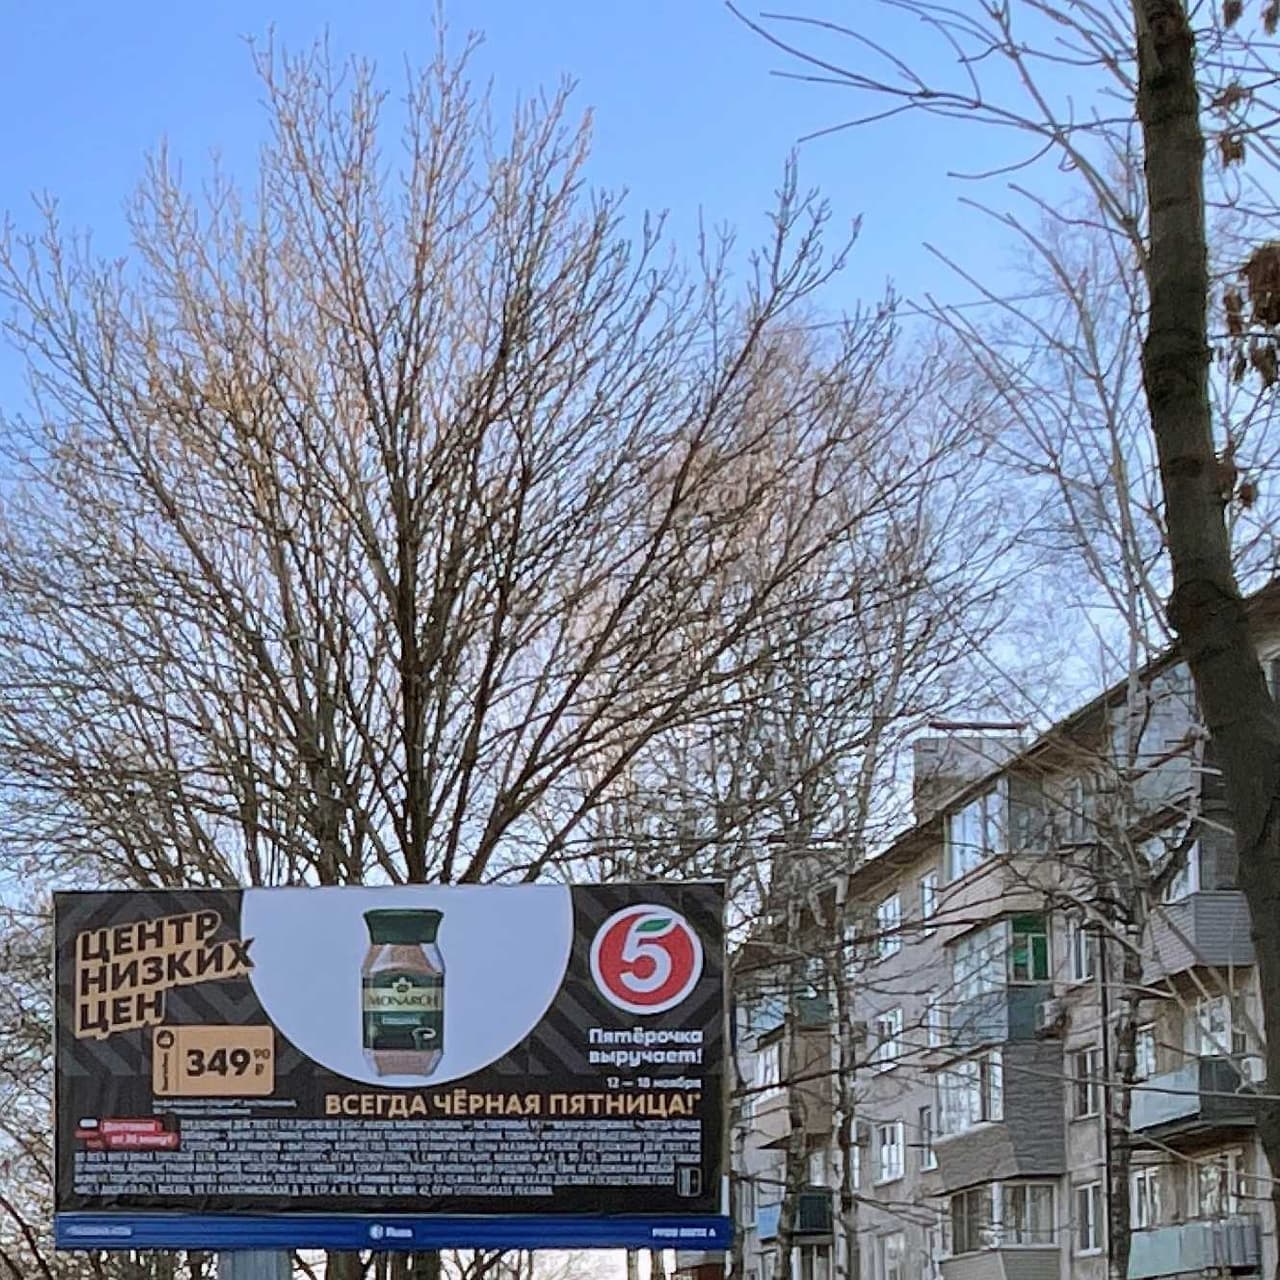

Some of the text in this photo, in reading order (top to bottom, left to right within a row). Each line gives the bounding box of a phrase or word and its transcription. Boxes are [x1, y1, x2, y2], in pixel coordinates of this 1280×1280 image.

[81, 911, 219, 963] ЦЕНТР
[80, 937, 255, 997] НИЗКИХ
[79, 990, 162, 1033] ЦЕН
[590, 1027, 704, 1046] Пятёрочка
[186, 1047, 251, 1077] 349
[590, 1048, 703, 1067] выручает!
[325, 1094, 427, 1118] ВСЕГДА
[433, 1088, 541, 1116] ЧЁРНАЯ
